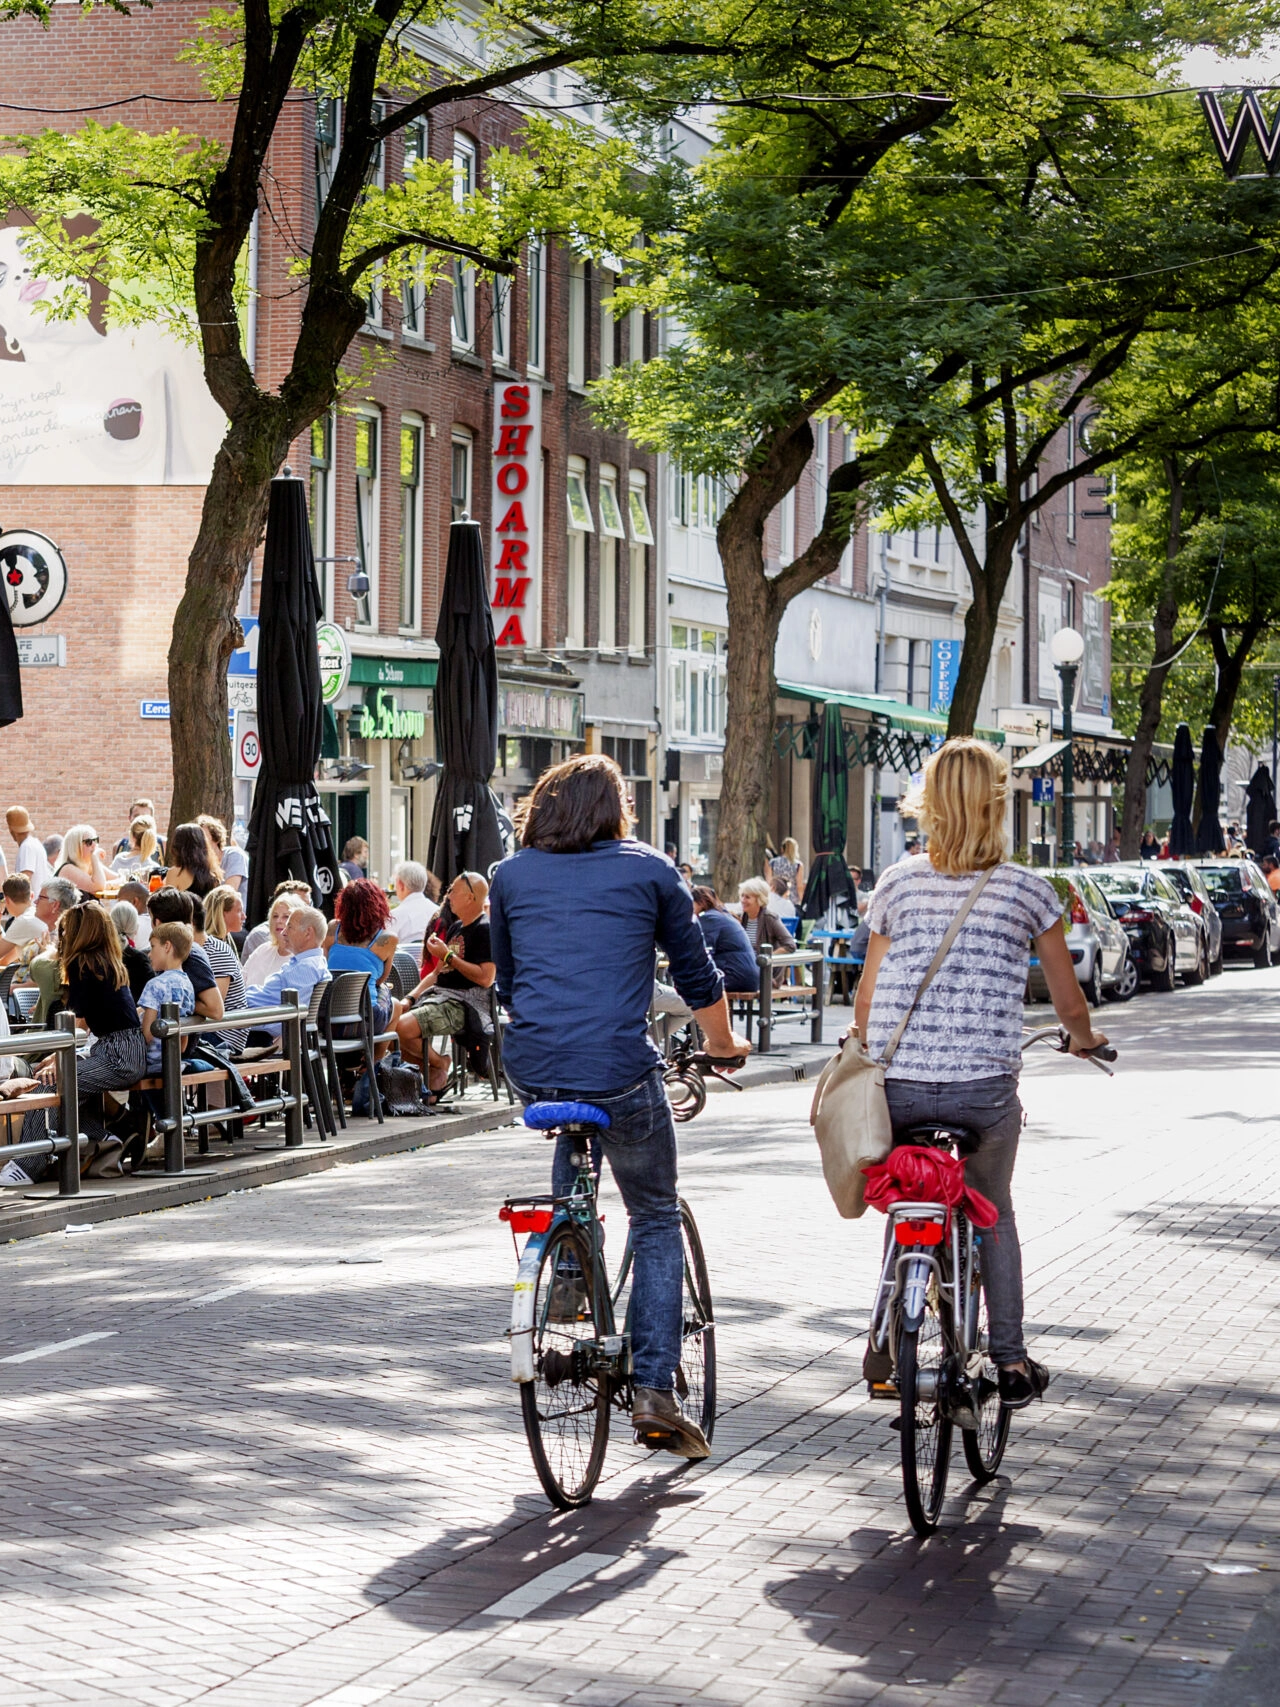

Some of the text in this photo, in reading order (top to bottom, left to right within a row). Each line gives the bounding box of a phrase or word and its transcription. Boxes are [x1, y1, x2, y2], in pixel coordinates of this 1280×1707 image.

[491, 384, 533, 648] SHOARMA
[18, 640, 33, 650] FE
[33, 652, 55, 663] AAP
[937, 641, 952, 700] COFFEE
[375, 687, 424, 739] Schouw
[245, 743, 257, 756] 30
[1042, 778, 1052, 793] P
